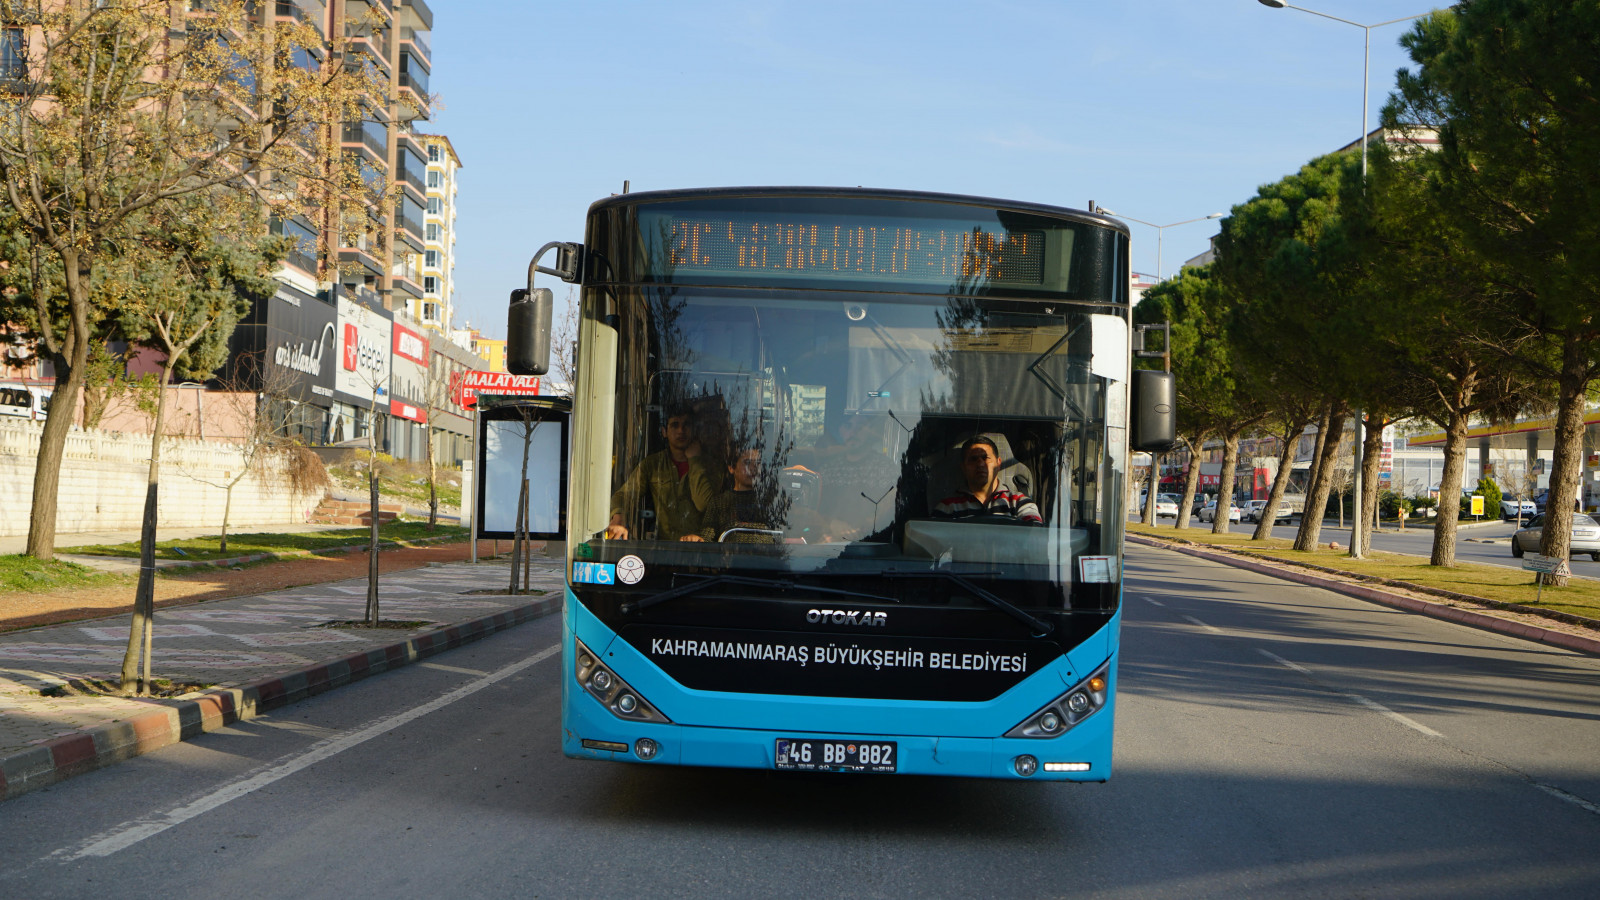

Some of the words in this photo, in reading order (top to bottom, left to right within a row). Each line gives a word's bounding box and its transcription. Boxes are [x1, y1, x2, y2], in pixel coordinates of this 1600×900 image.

[464, 373, 538, 388] MALATYALI
[463, 388, 473, 398] ET
[806, 609, 888, 627] OTOKAR
[651, 638, 809, 667] KAHRAMANMARAŞ
[814, 643, 924, 670] BÜYÜKŞEHİR
[929, 651, 1027, 673] BELEDİYESİ
[789, 742, 812, 762] 46
[823, 743, 846, 764] BB
[859, 744, 893, 765] 882
